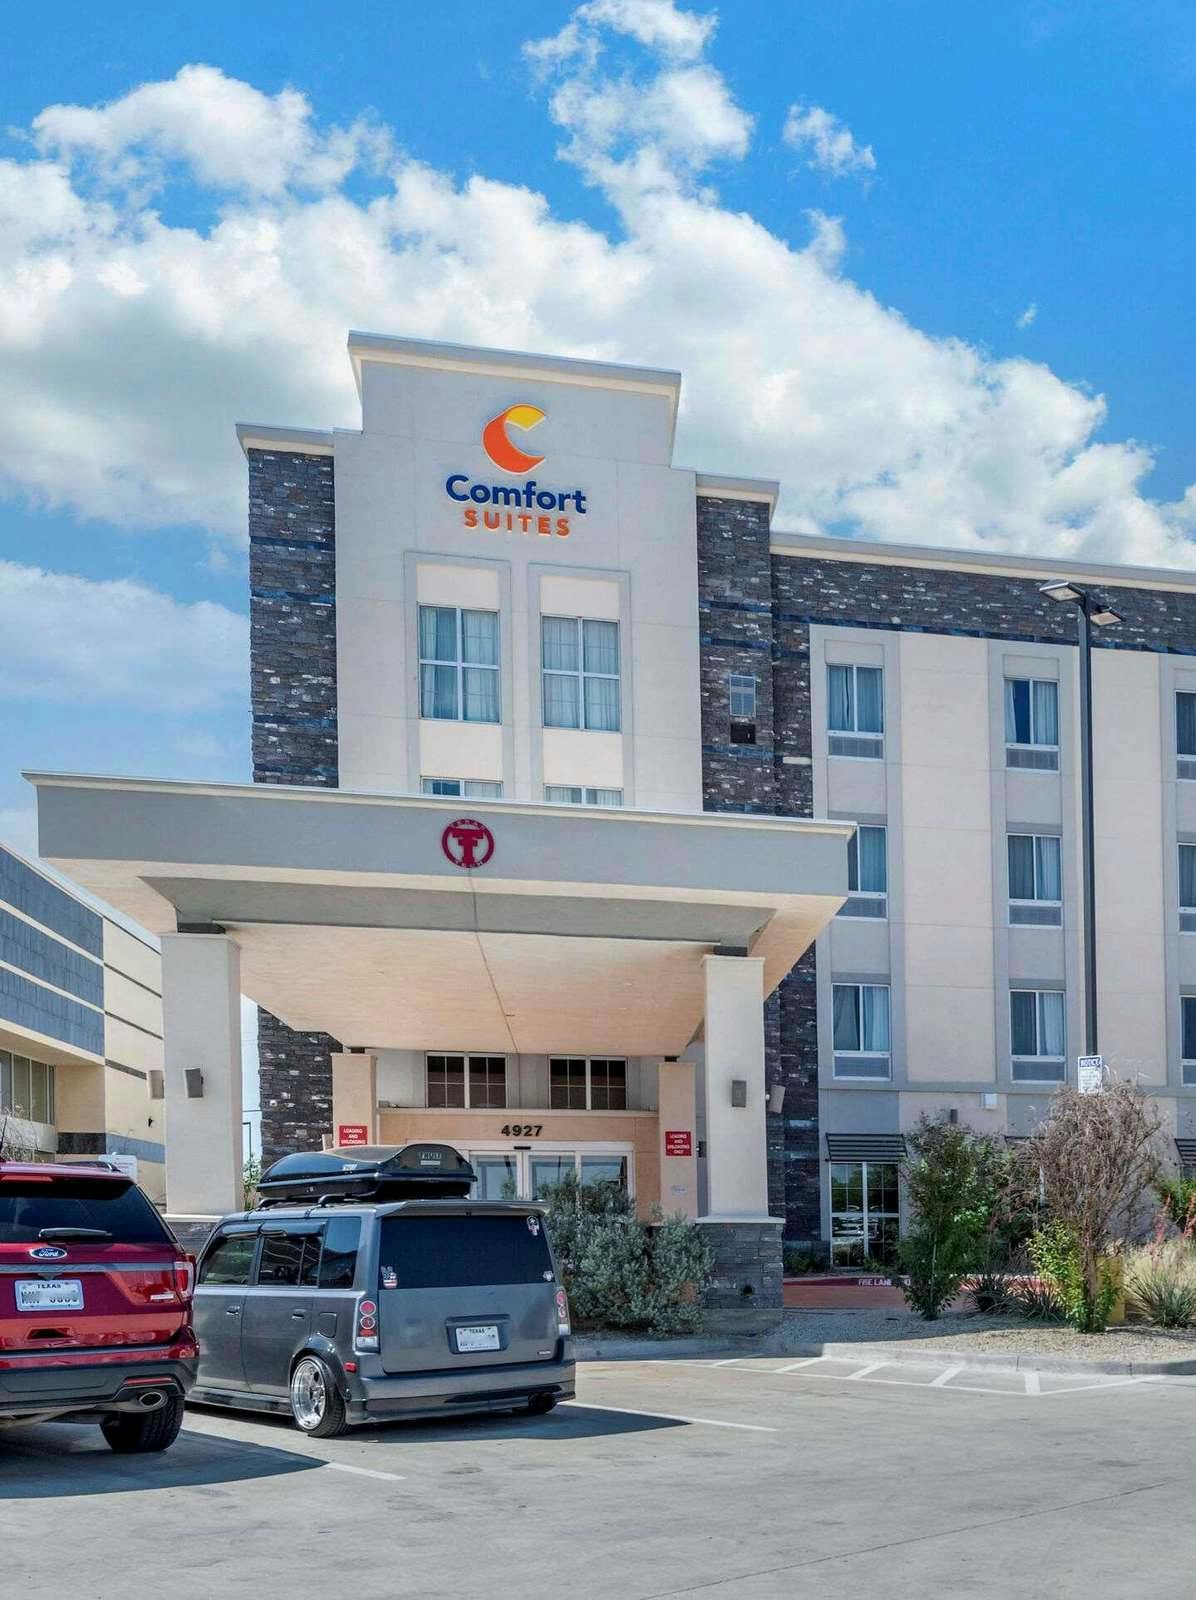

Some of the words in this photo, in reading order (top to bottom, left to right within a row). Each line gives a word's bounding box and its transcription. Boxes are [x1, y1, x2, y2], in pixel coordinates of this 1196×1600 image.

[445, 474, 588, 515] Comfort
[463, 509, 571, 538] SUITES
[501, 1124, 543, 1137] 4927
[38, 1248, 60, 1257] Ford
[857, 1278, 873, 1286] FIRE
